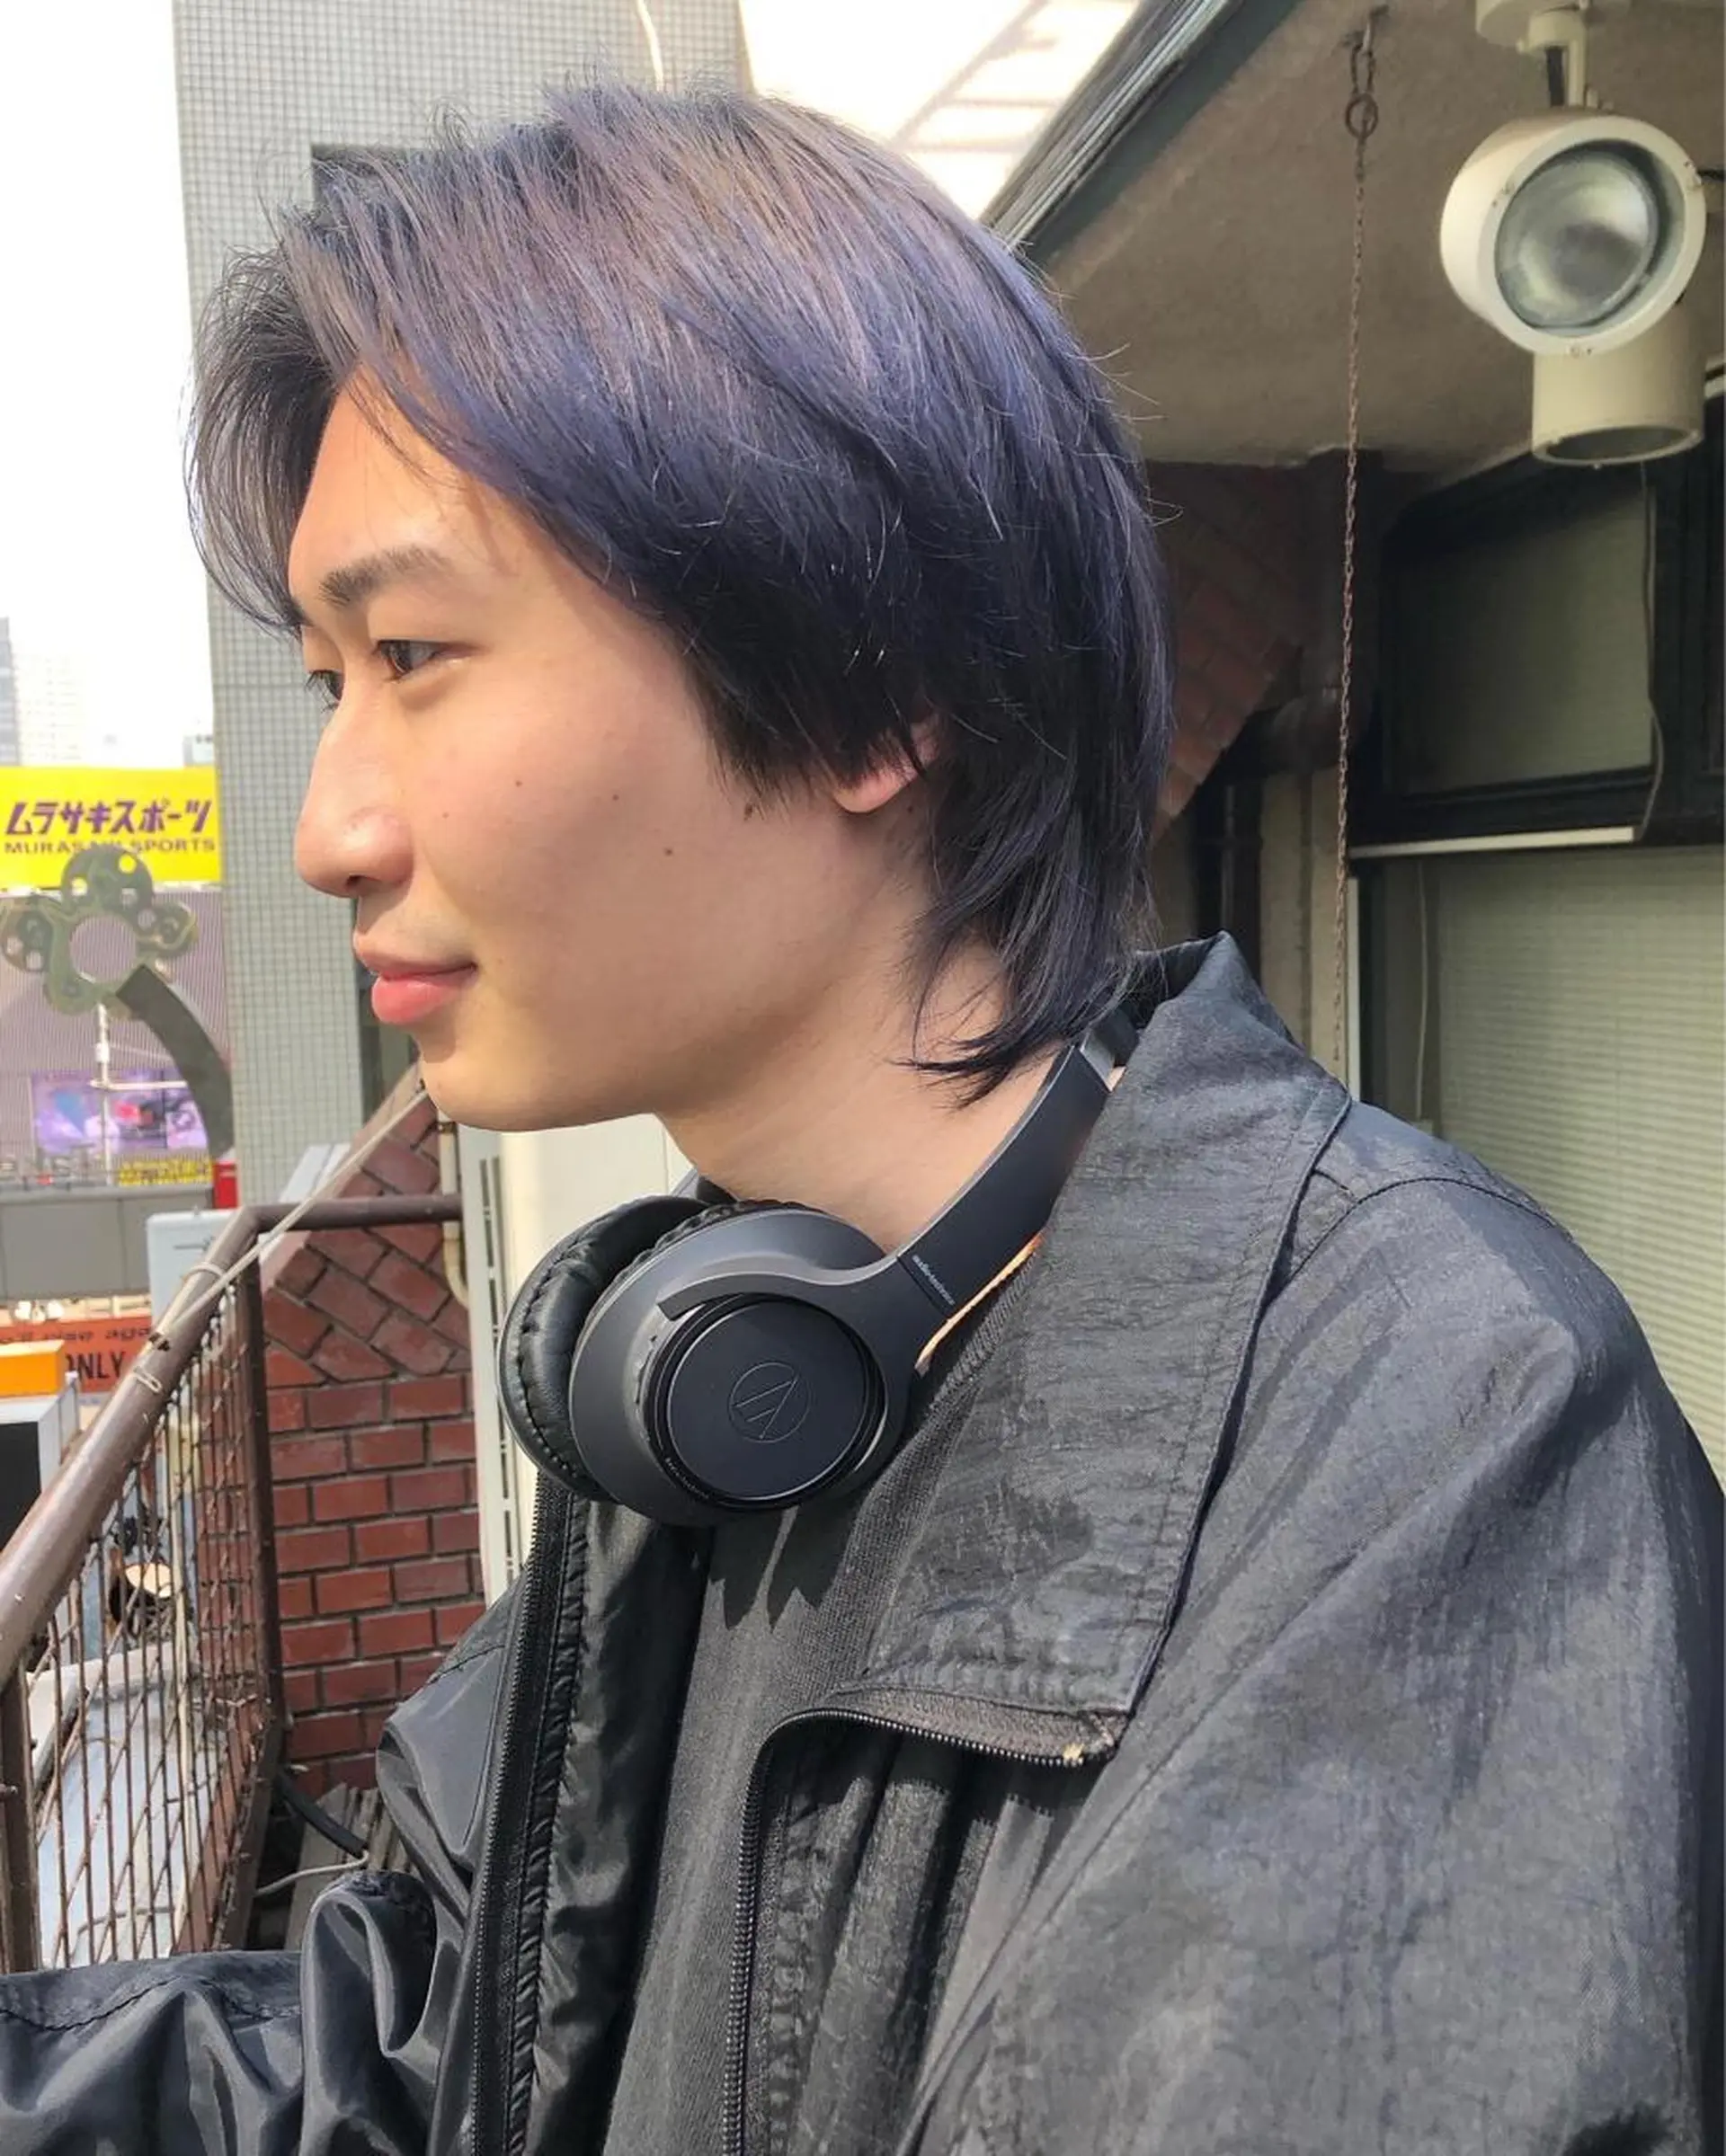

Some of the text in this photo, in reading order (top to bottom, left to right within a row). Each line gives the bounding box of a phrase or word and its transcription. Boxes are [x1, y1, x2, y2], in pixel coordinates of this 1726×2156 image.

[5, 798, 211, 835] ムラサキスポーツ
